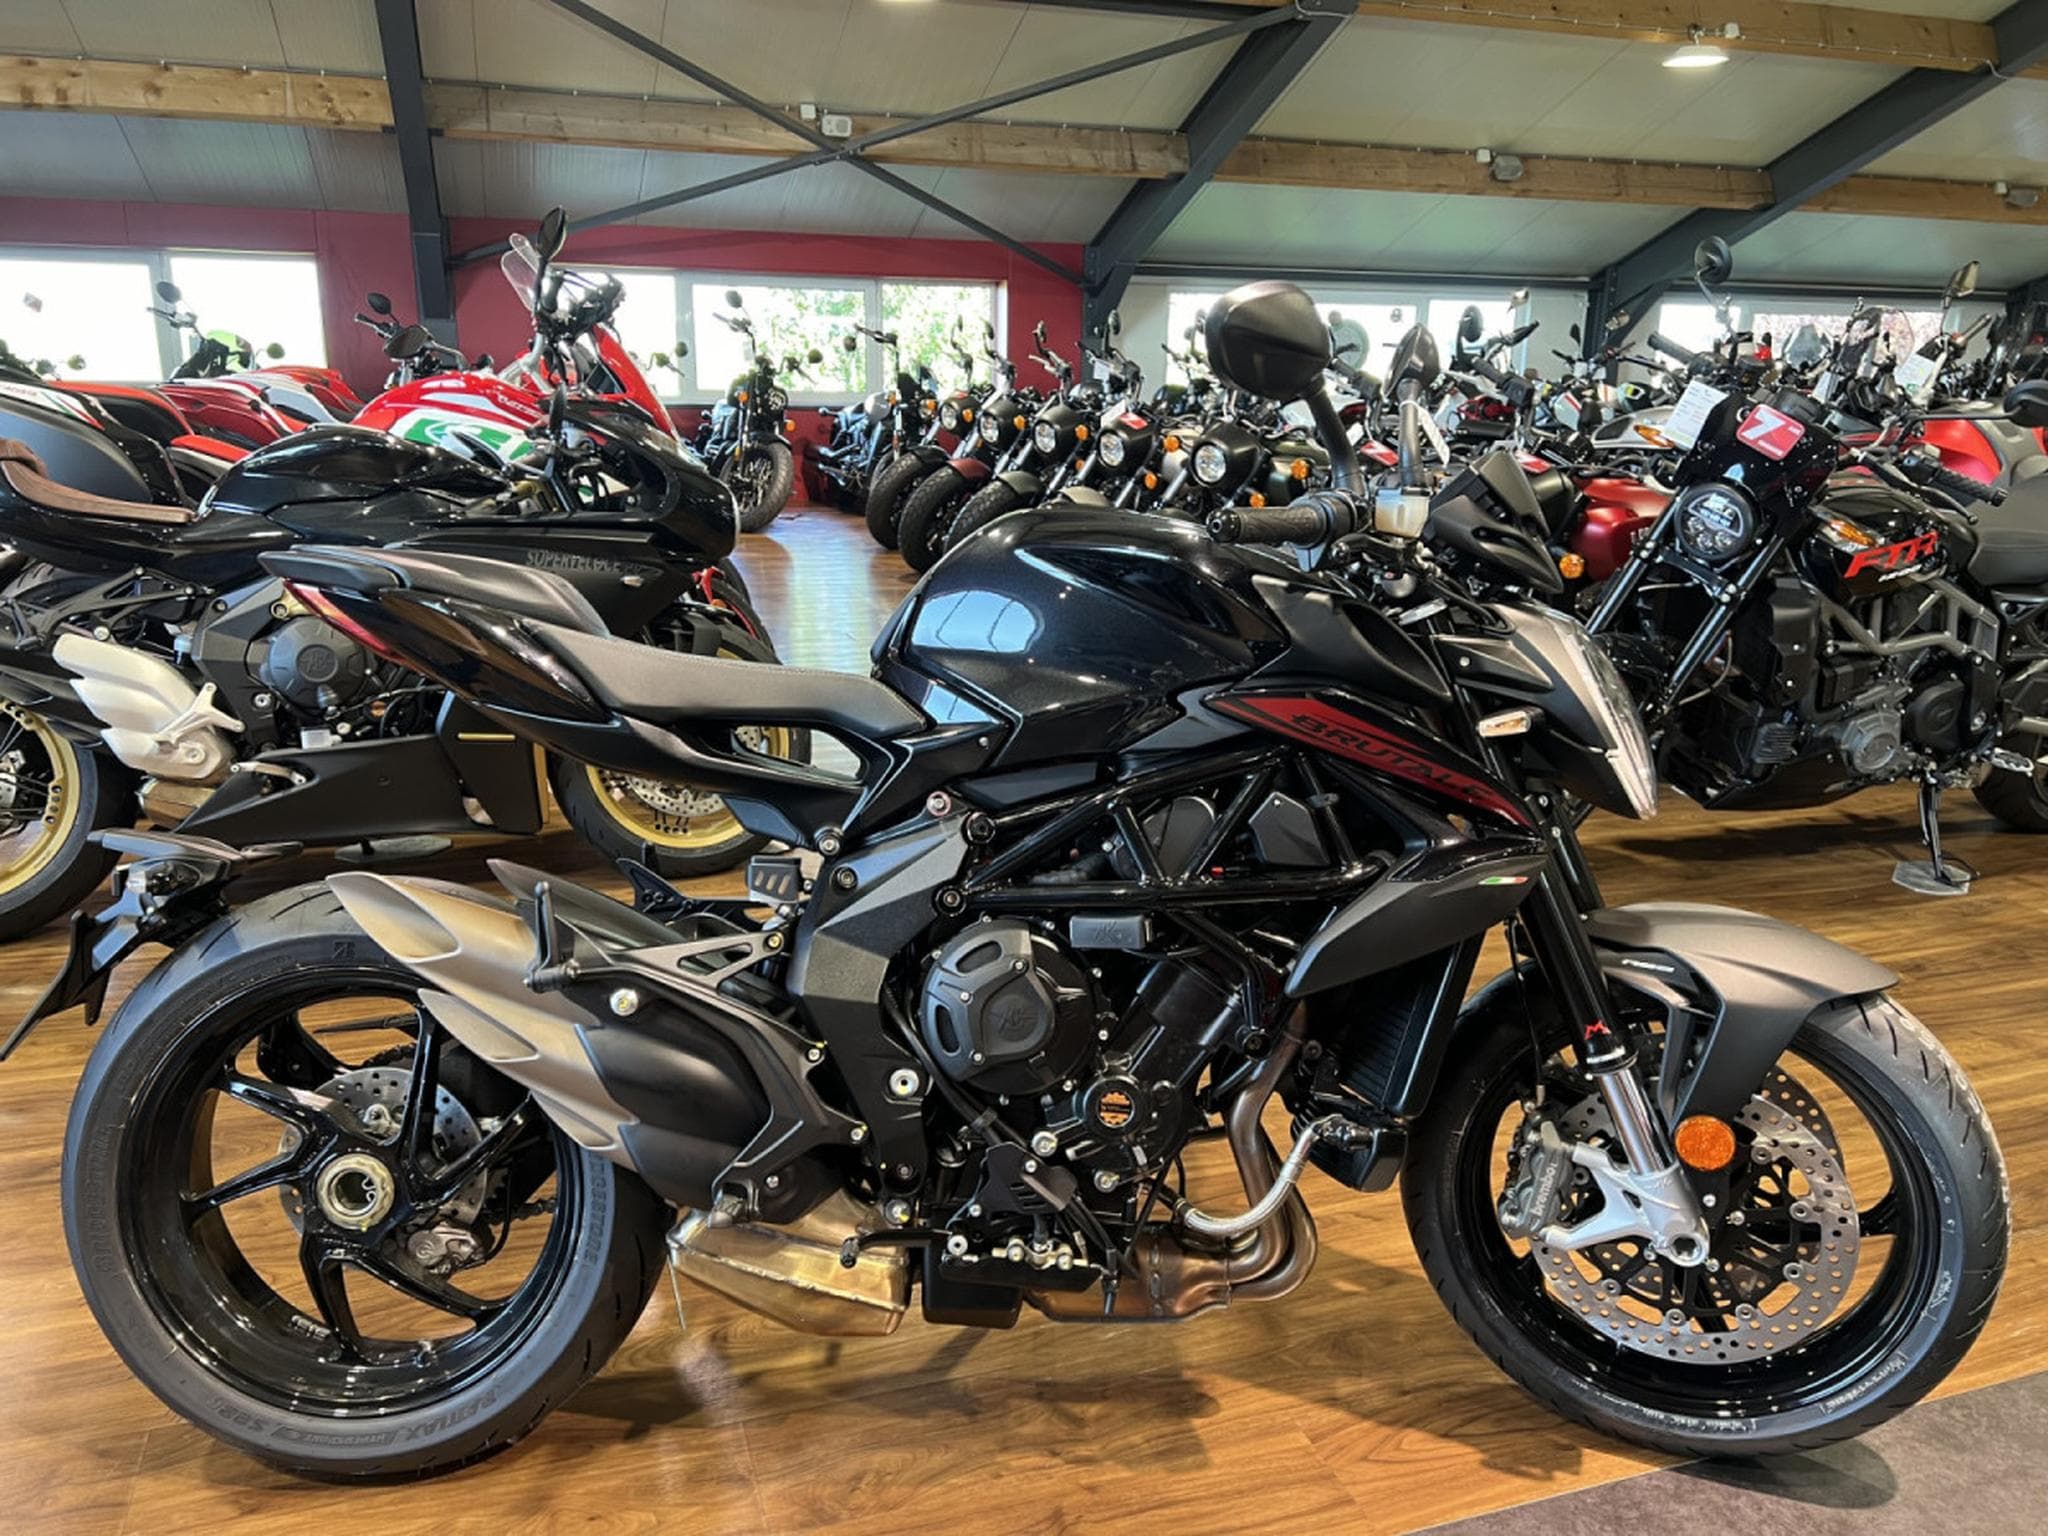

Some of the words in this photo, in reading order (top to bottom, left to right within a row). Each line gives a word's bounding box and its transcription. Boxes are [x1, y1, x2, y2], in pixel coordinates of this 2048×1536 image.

[526, 551, 622, 575] SUPERVELOCE
[1844, 529, 1938, 579] FTR
[1291, 713, 1493, 799] BRUTALE
[1530, 1167, 1557, 1217] brembo
